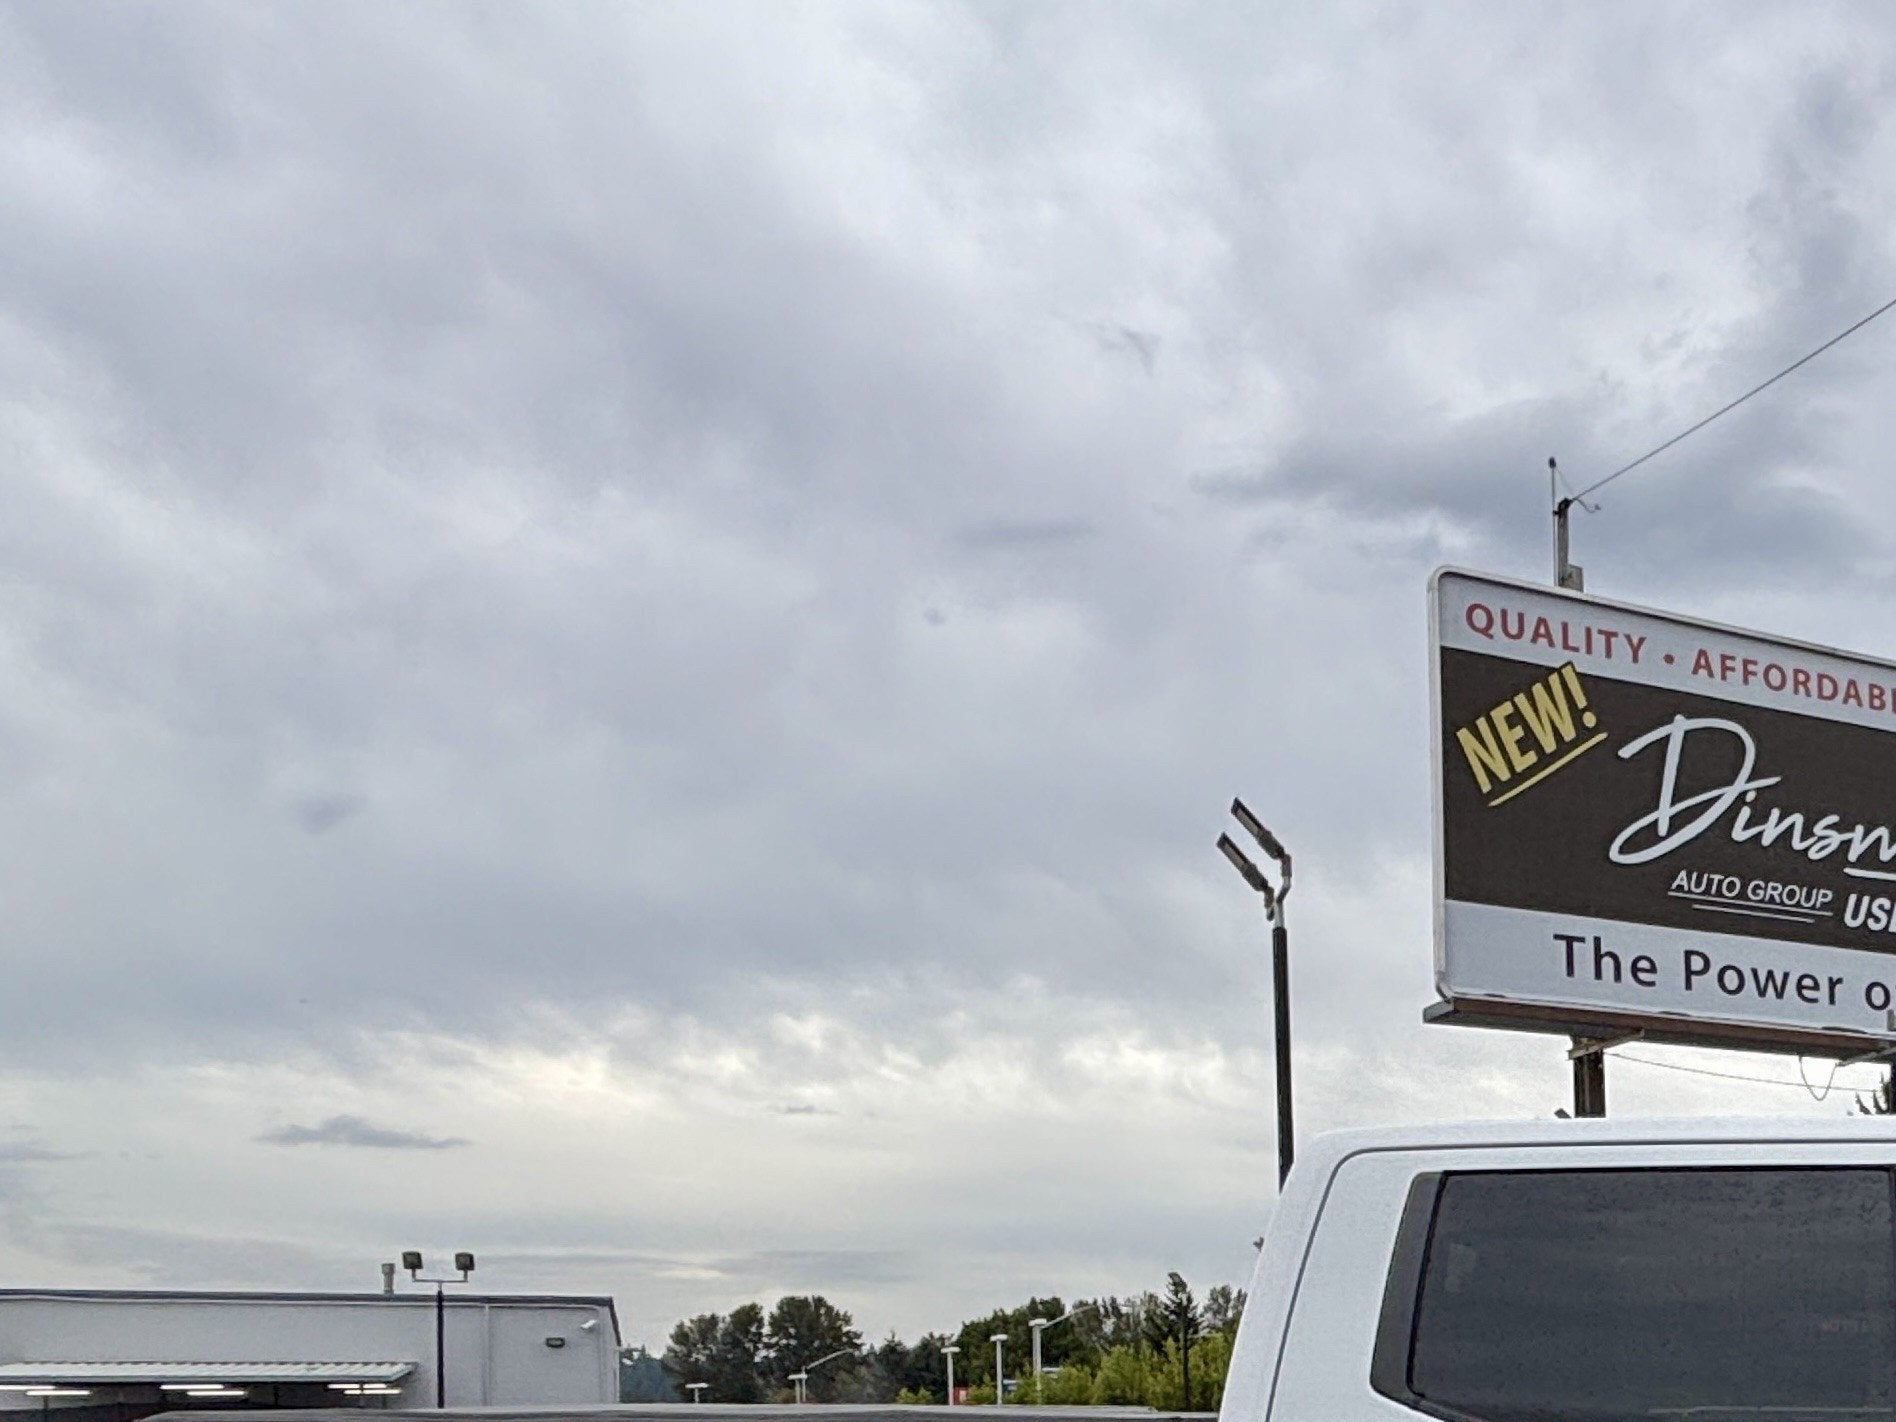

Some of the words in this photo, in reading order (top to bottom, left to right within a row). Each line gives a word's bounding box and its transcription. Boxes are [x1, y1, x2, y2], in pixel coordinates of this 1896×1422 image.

[1465, 603, 1647, 664] QUALITY
[1455, 663, 1597, 794] NEW!
[1671, 869, 1742, 898] AUTO
[1747, 879, 1834, 909] GROUP
[1553, 934, 1658, 988] The
[1684, 949, 1843, 1005] Power
